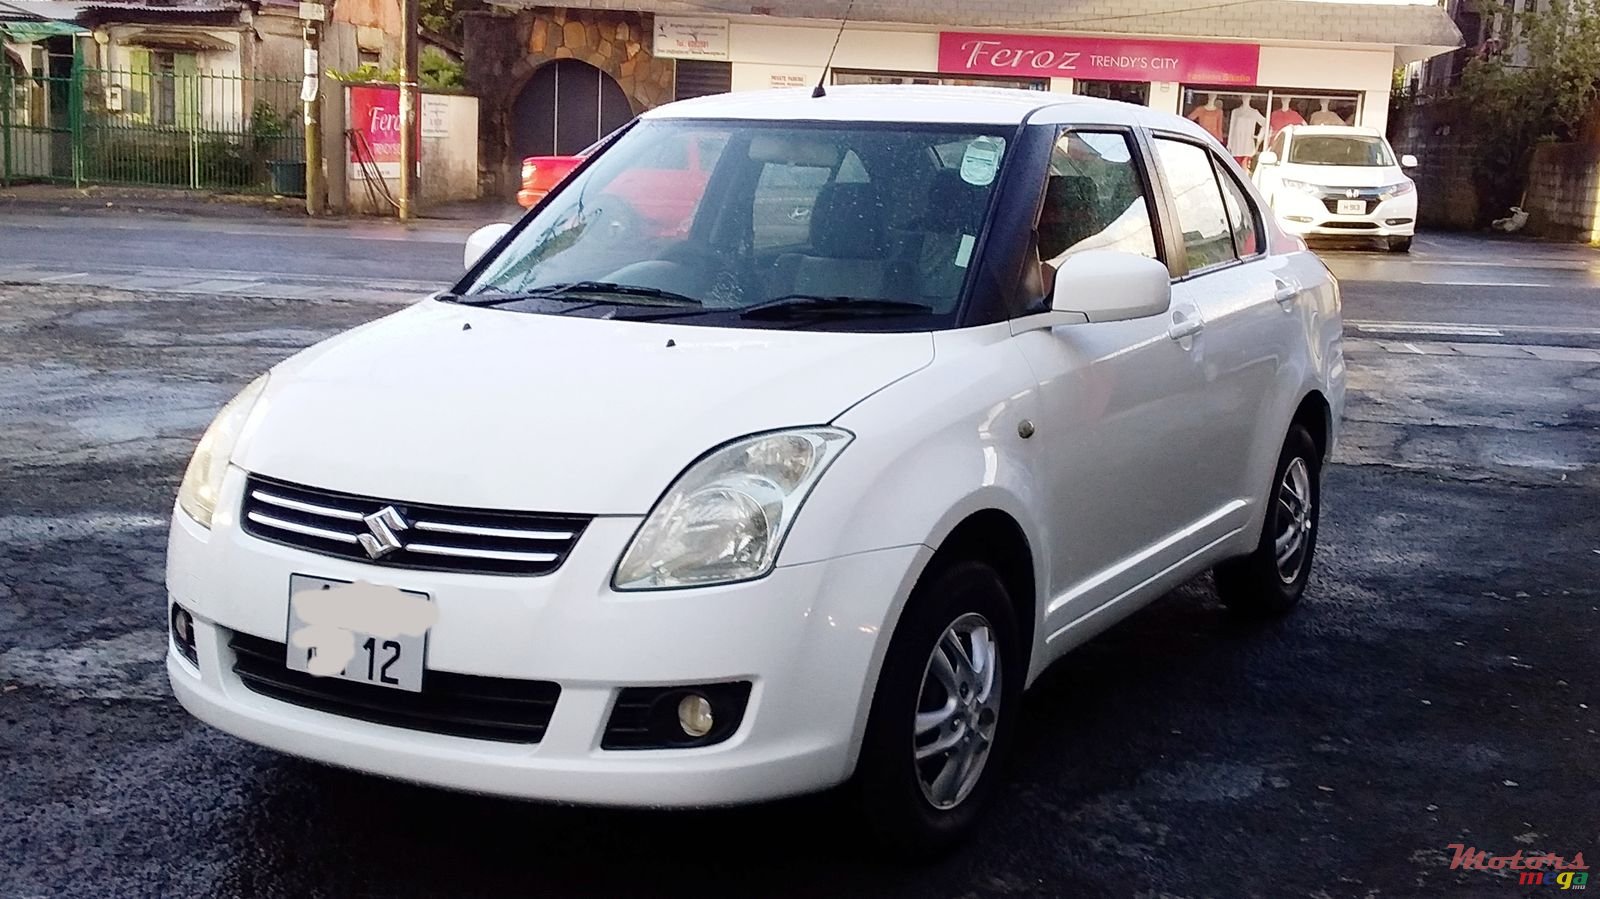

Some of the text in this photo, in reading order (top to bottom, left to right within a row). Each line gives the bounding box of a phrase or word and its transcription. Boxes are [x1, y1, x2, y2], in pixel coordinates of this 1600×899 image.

[961, 40, 1081, 70] Feroz
[1089, 54, 1179, 69] TRENDY'S CITY
[368, 106, 400, 133] Fero
[362, 637, 401, 685] 12
